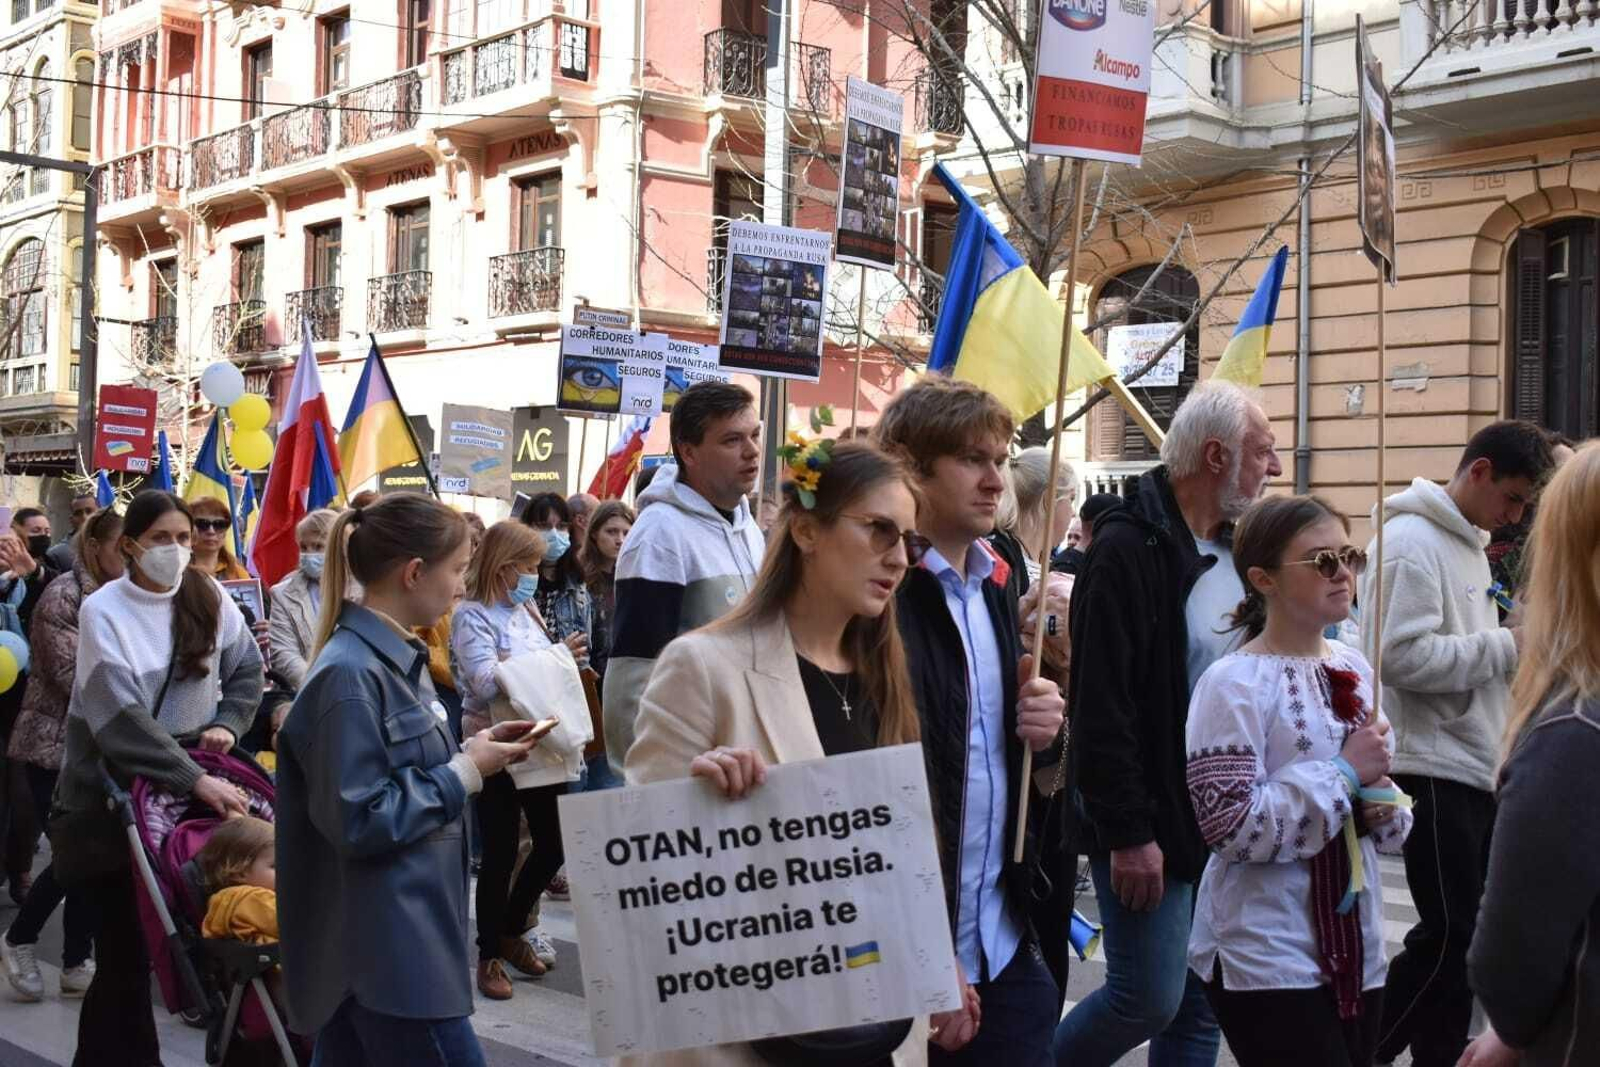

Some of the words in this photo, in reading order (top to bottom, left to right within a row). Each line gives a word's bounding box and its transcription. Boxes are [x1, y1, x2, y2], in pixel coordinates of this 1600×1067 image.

[1093, 49, 1140, 80] Alcampo
[1051, 83, 1136, 111] FINANCIAMOS
[509, 133, 562, 159] ATENAS
[386, 162, 430, 186] ATENAS
[732, 228, 768, 241] DEBEMOS
[770, 234, 829, 250] ENFRENTARNOS
[741, 244, 751, 253] LA
[754, 245, 803, 260] PROPAGANDA
[579, 311, 597, 321] PUTIN
[570, 328, 634, 344] CORREDORES
[592, 345, 664, 361] HUMANITARIOS
[618, 365, 661, 379] SEGUROS
[517, 427, 553, 462] AG
[446, 478, 466, 488] nrd
[605, 826, 712, 866] OTAN,
[718, 825, 762, 850] no
[769, 805, 892, 842] tengas
[618, 872, 726, 909] miedo
[735, 864, 778, 893] de
[785, 847, 894, 886] Rusia.
[666, 903, 814, 954] ¡Ucrania
[820, 900, 858, 926] te
[656, 944, 843, 1003] protegerá!
